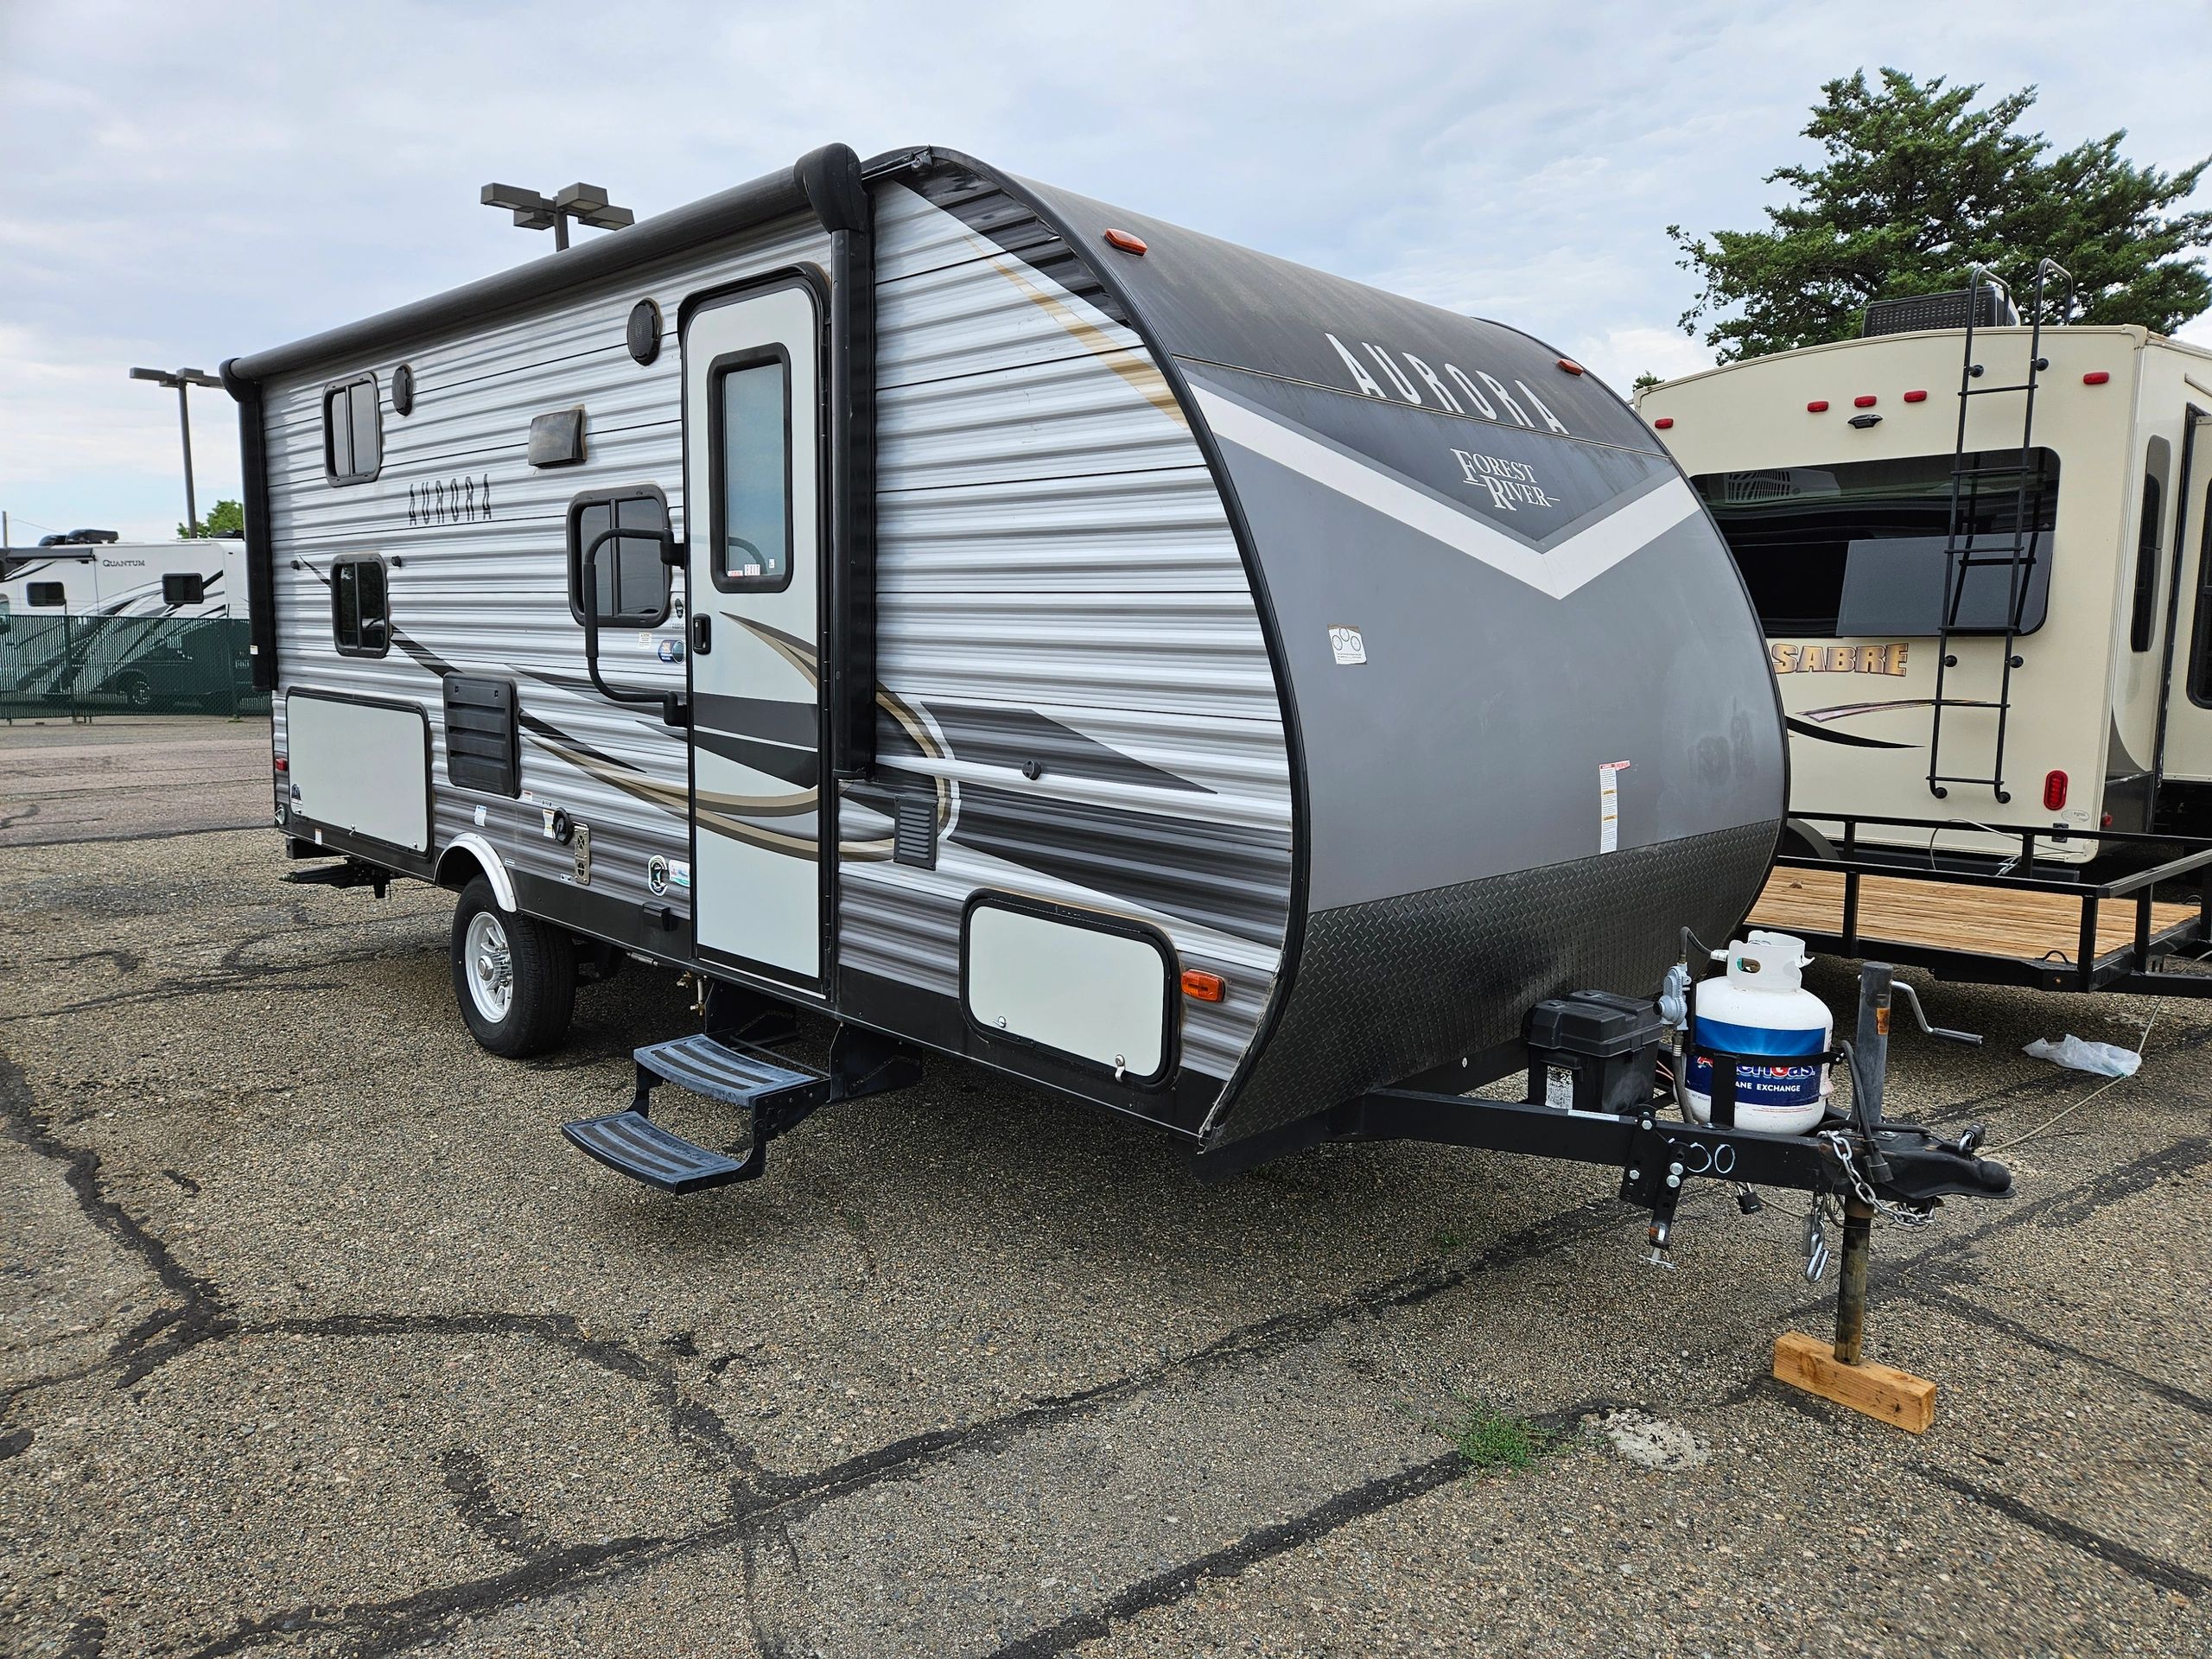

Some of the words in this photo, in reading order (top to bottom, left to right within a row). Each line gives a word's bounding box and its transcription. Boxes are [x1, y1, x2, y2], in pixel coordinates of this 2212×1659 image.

[1325, 333, 1569, 435] AURORA
[1450, 448, 1537, 483] FOREST
[409, 474, 492, 525] AURORA
[1480, 474, 1553, 511] RIVER
[1771, 643, 1909, 677] SABRE
[1547, 1065, 1573, 1075] NOCO
[1560, 1073, 1573, 1083] 24
[1757, 1084, 1801, 1092] EXCHANGE
